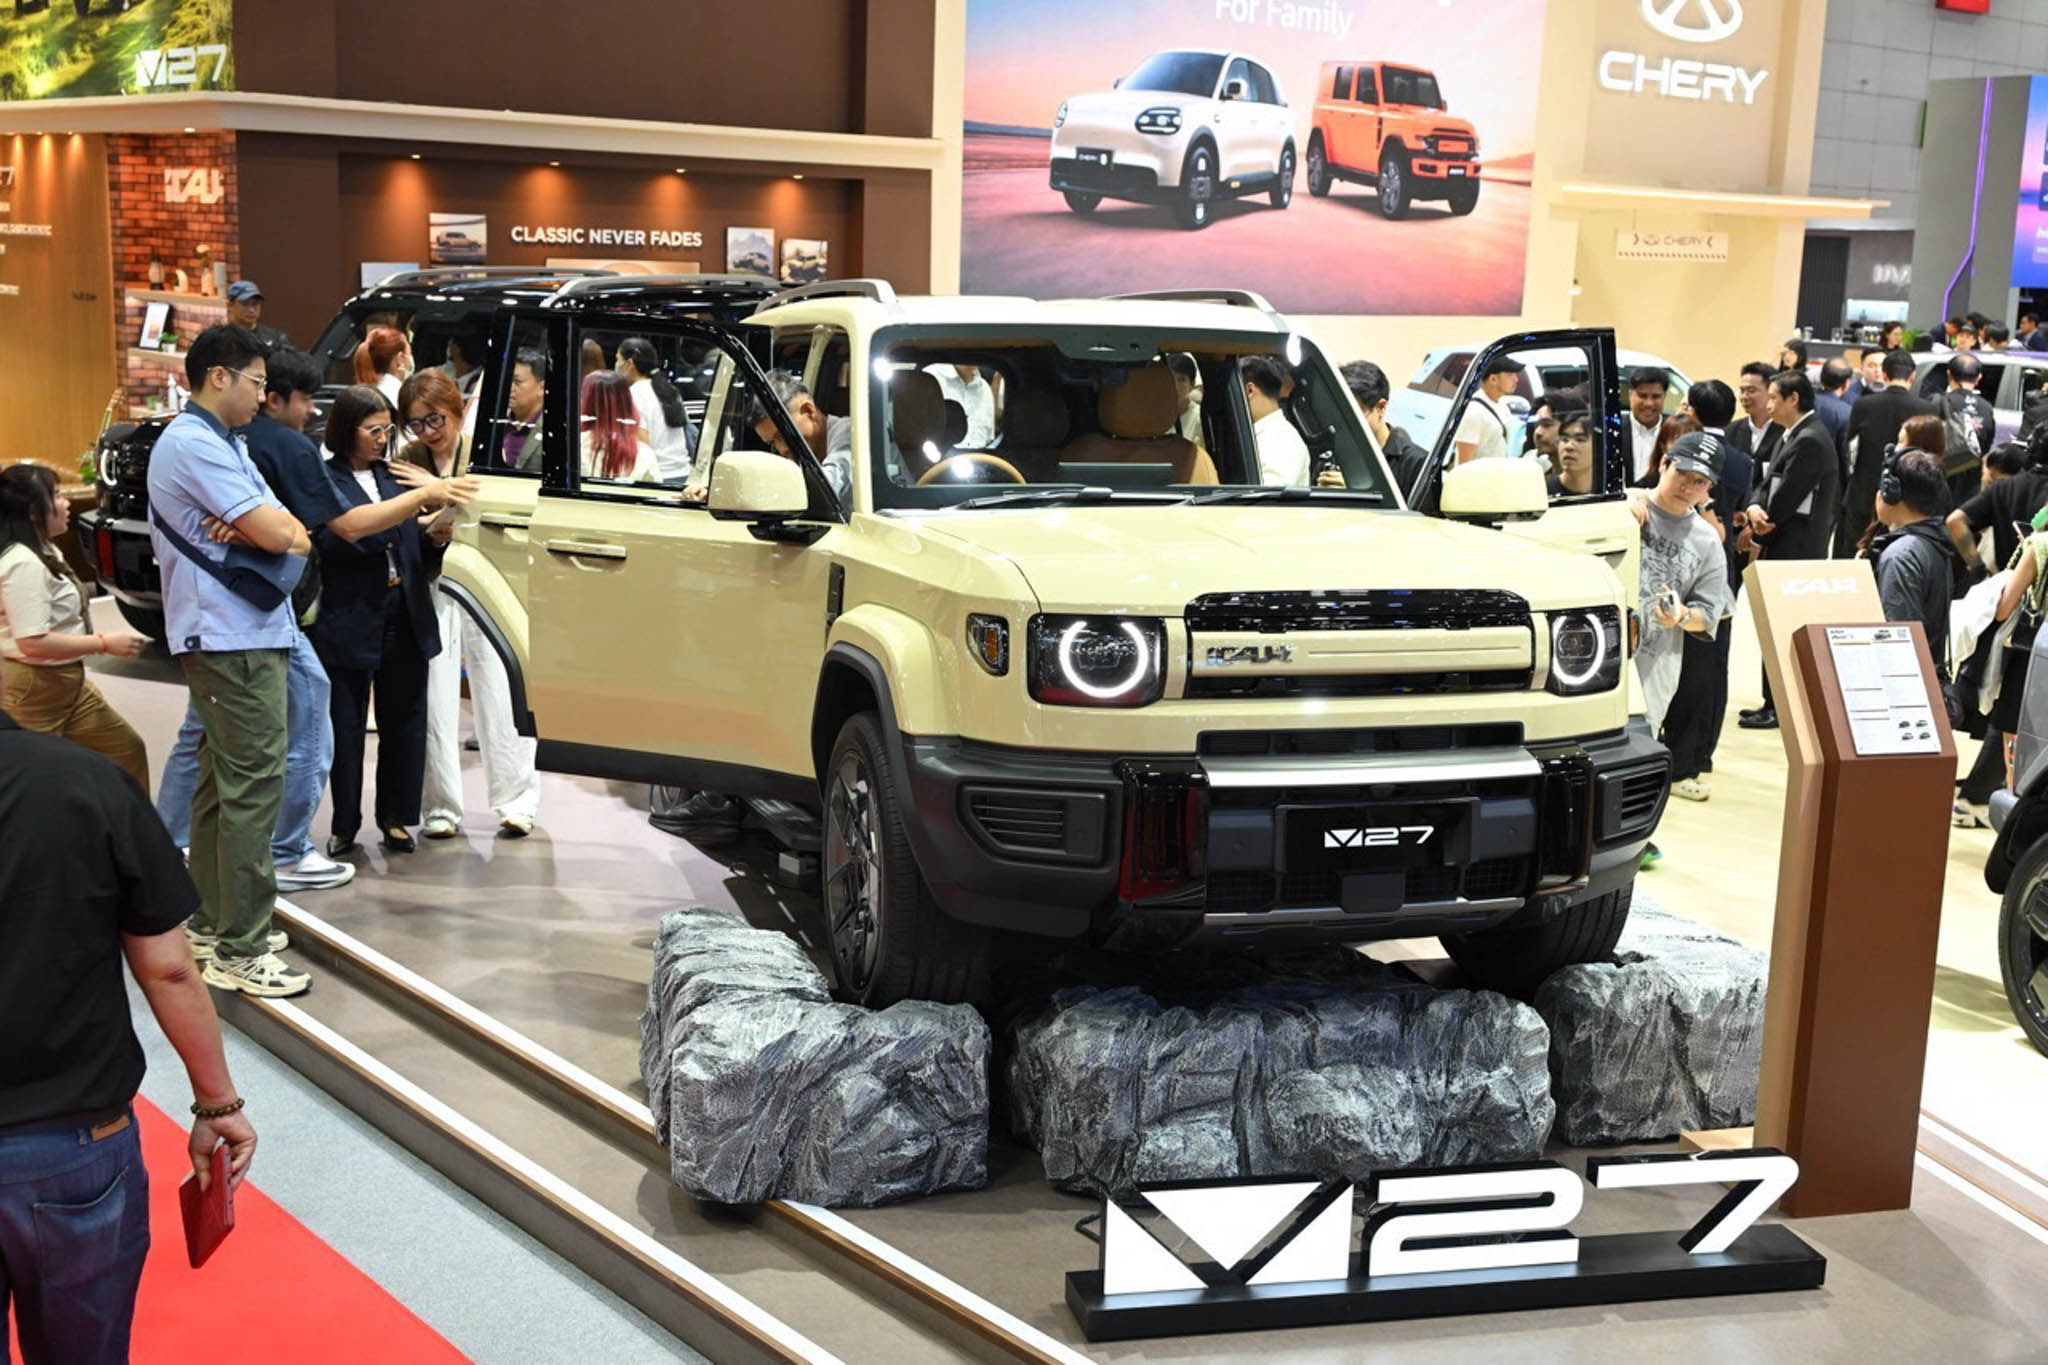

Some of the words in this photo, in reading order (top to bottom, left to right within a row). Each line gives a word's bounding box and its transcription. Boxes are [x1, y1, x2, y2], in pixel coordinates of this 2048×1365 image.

[1215, 0, 1257, 24] For
[1267, 0, 1354, 41] Family
[135, 44, 227, 87] M27
[1599, 50, 1769, 105] CHERY
[511, 226, 584, 244] CLASSIC
[588, 228, 646, 246] NEVER
[650, 230, 703, 247] FADES
[1324, 825, 1434, 848] M27
[1103, 1155, 1800, 1295] M27
